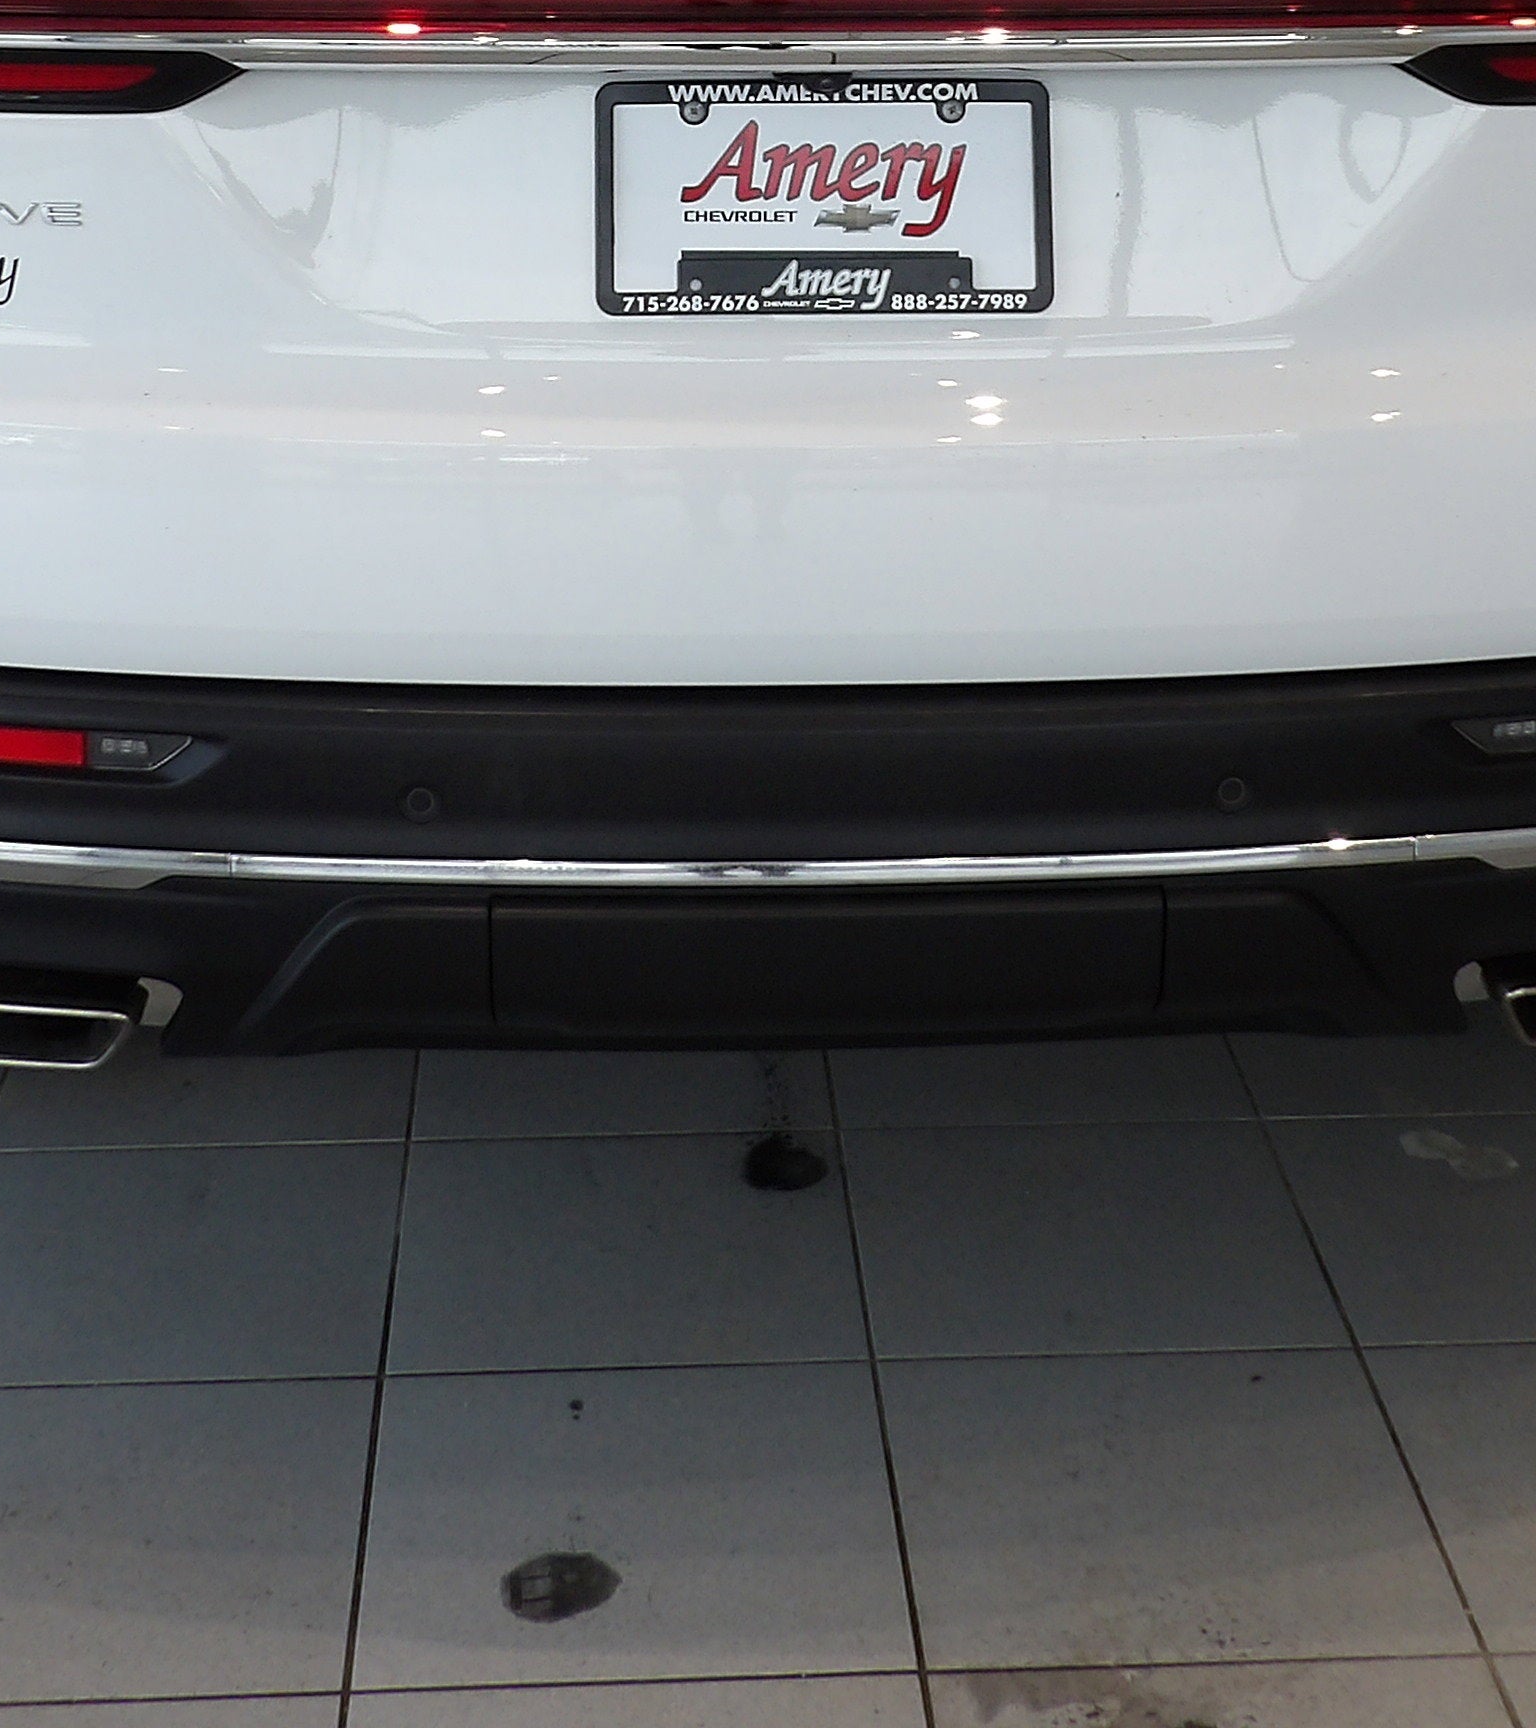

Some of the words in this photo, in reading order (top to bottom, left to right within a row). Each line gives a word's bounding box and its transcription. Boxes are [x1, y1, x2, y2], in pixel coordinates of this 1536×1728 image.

[680, 119, 967, 238] Amery
[683, 210, 798, 223] CHEVROLET
[761, 259, 891, 310] Amery
[622, 294, 760, 312] 715-268-7676
[763, 300, 811, 308] CHEVROLET
[891, 293, 1027, 310] 888-257-7989
